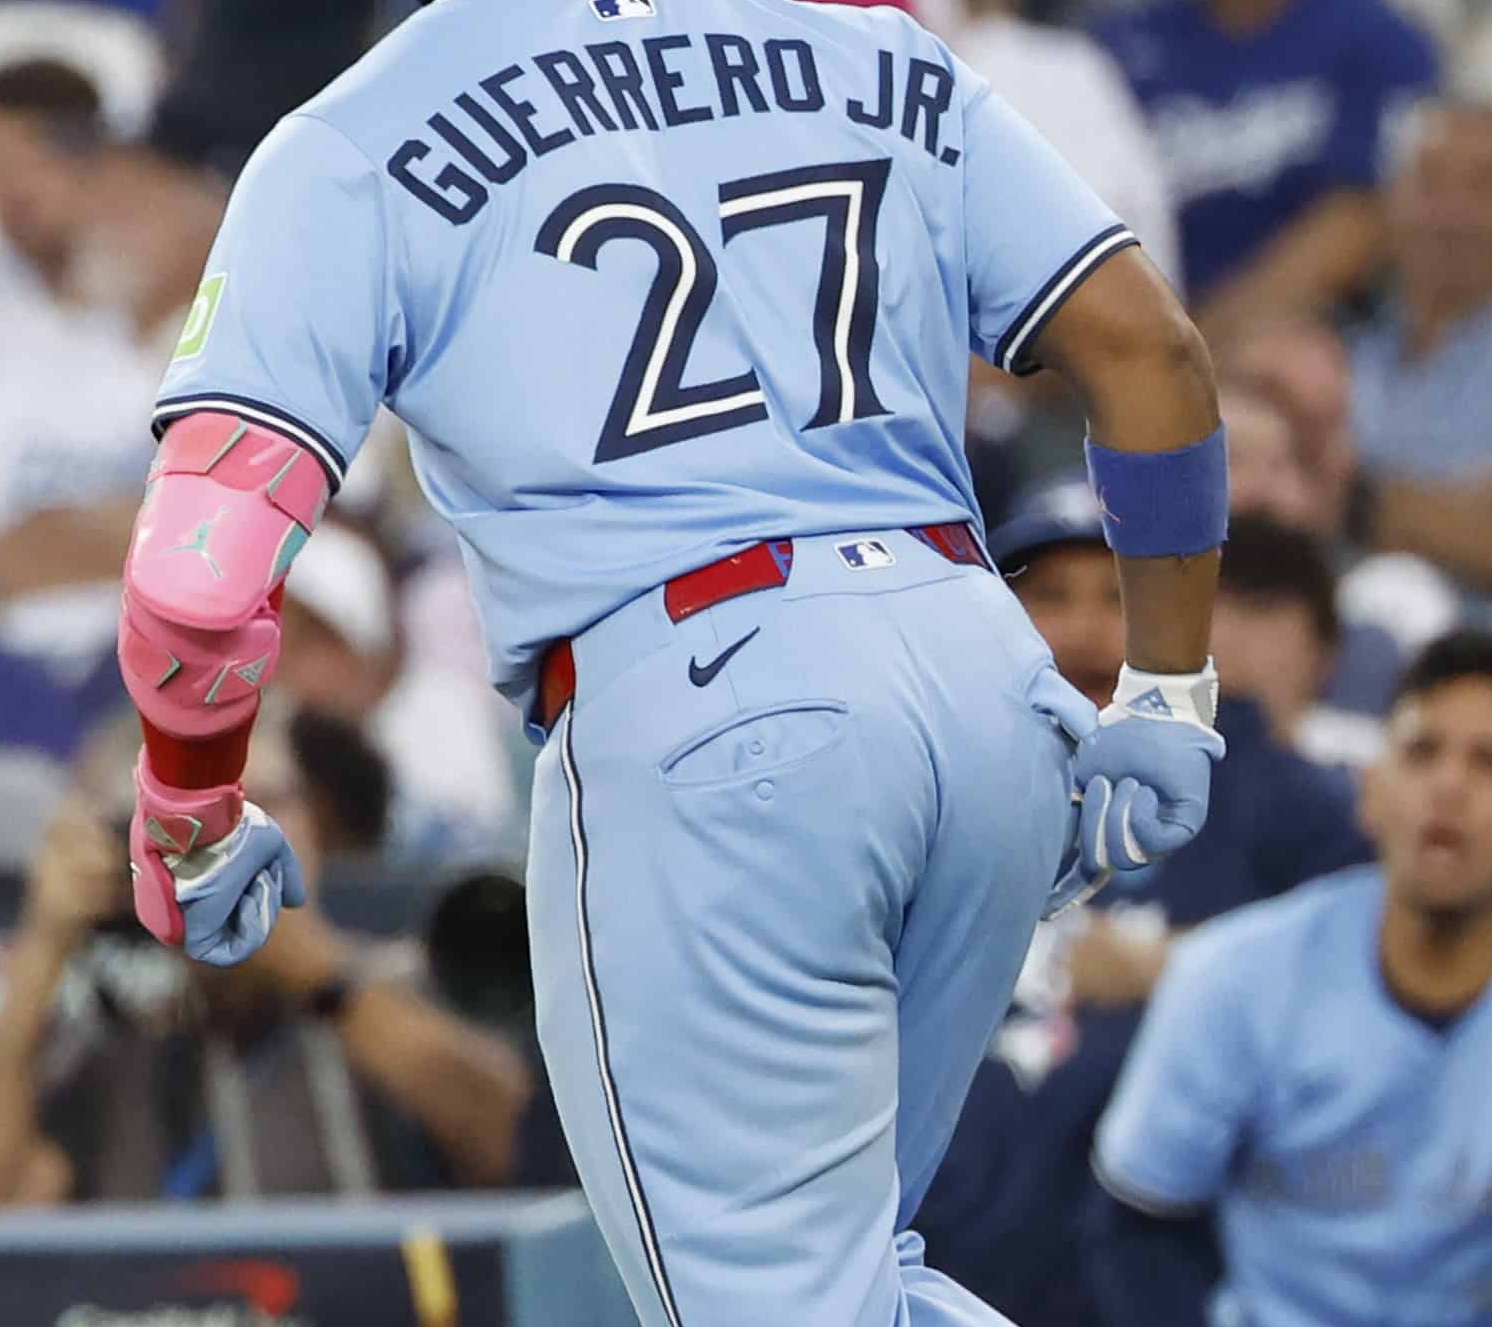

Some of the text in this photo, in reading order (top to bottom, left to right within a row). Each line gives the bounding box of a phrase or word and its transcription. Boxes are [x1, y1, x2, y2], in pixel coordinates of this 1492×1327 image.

[387, 32, 961, 226] GUERRERO JR.
[533, 158, 895, 465] 27
